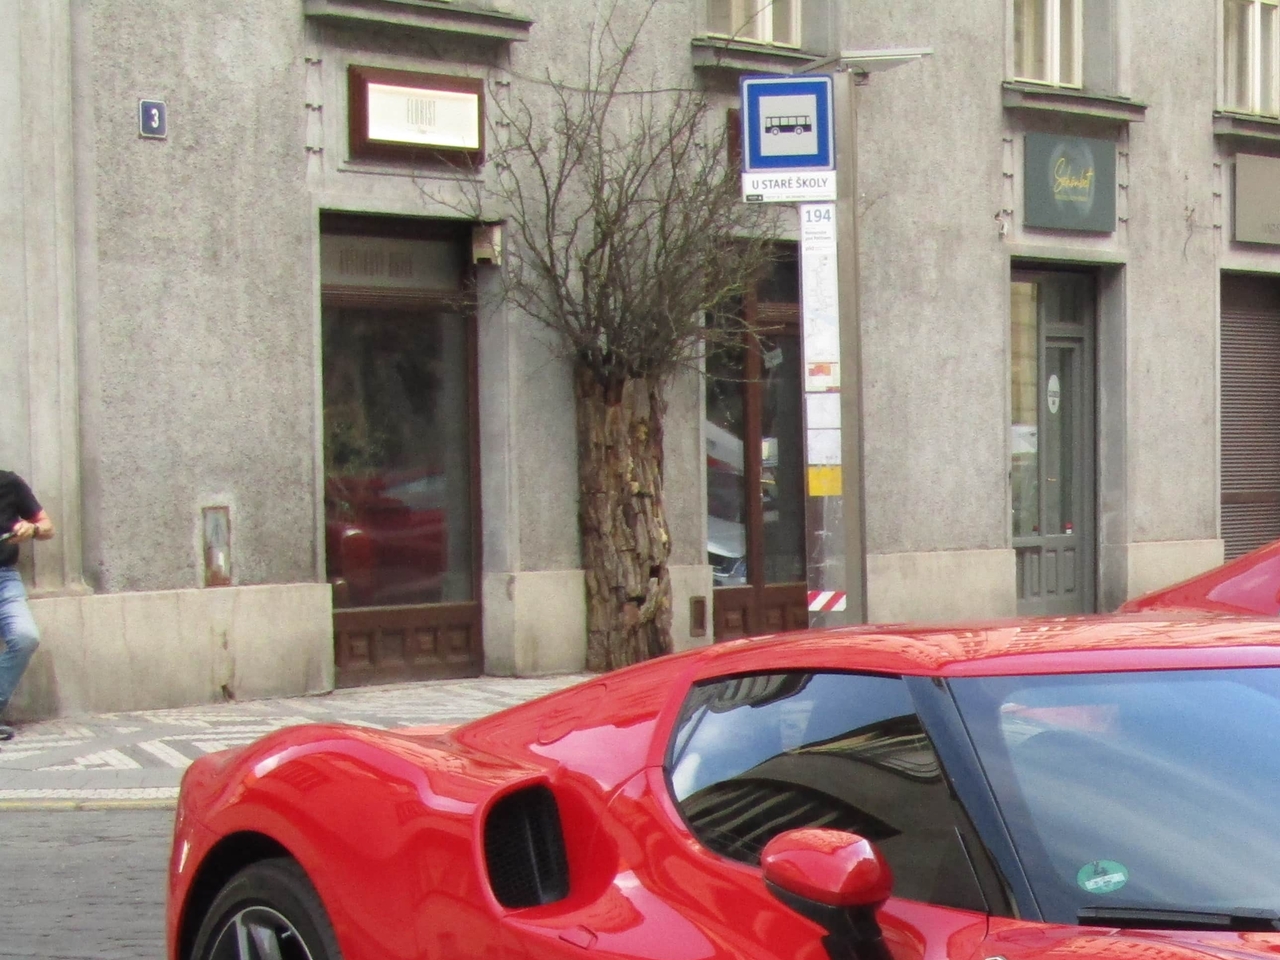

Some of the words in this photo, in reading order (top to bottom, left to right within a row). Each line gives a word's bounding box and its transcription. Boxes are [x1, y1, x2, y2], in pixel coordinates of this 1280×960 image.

[151, 108, 159, 128] 3
[752, 179, 759, 190] U
[761, 177, 793, 190] STARÉ
[795, 176, 828, 189] ŠKOLY
[805, 208, 831, 223] 194
